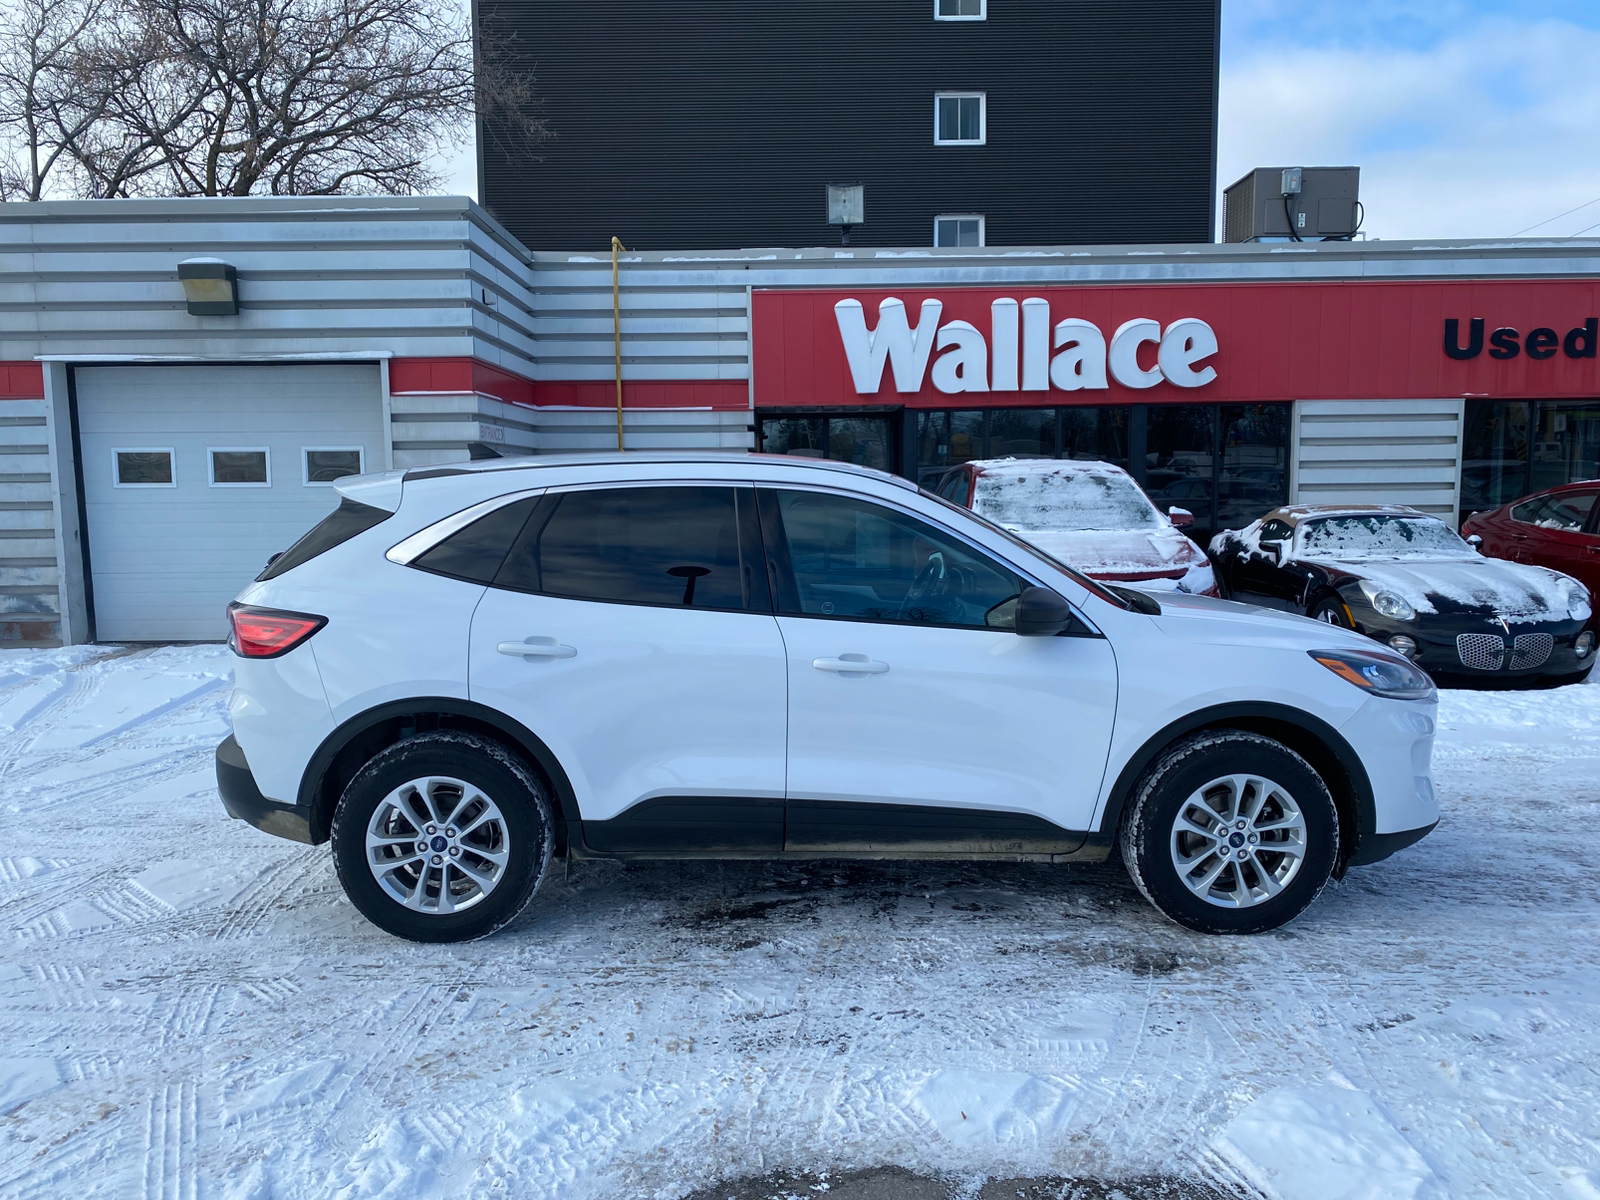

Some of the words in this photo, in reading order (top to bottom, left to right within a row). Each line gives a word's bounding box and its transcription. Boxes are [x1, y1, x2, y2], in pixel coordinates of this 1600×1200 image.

[834, 297, 1219, 394] Wallace
[1443, 317, 1599, 360] Used
[480, 425, 501, 441] ENTRANCE
